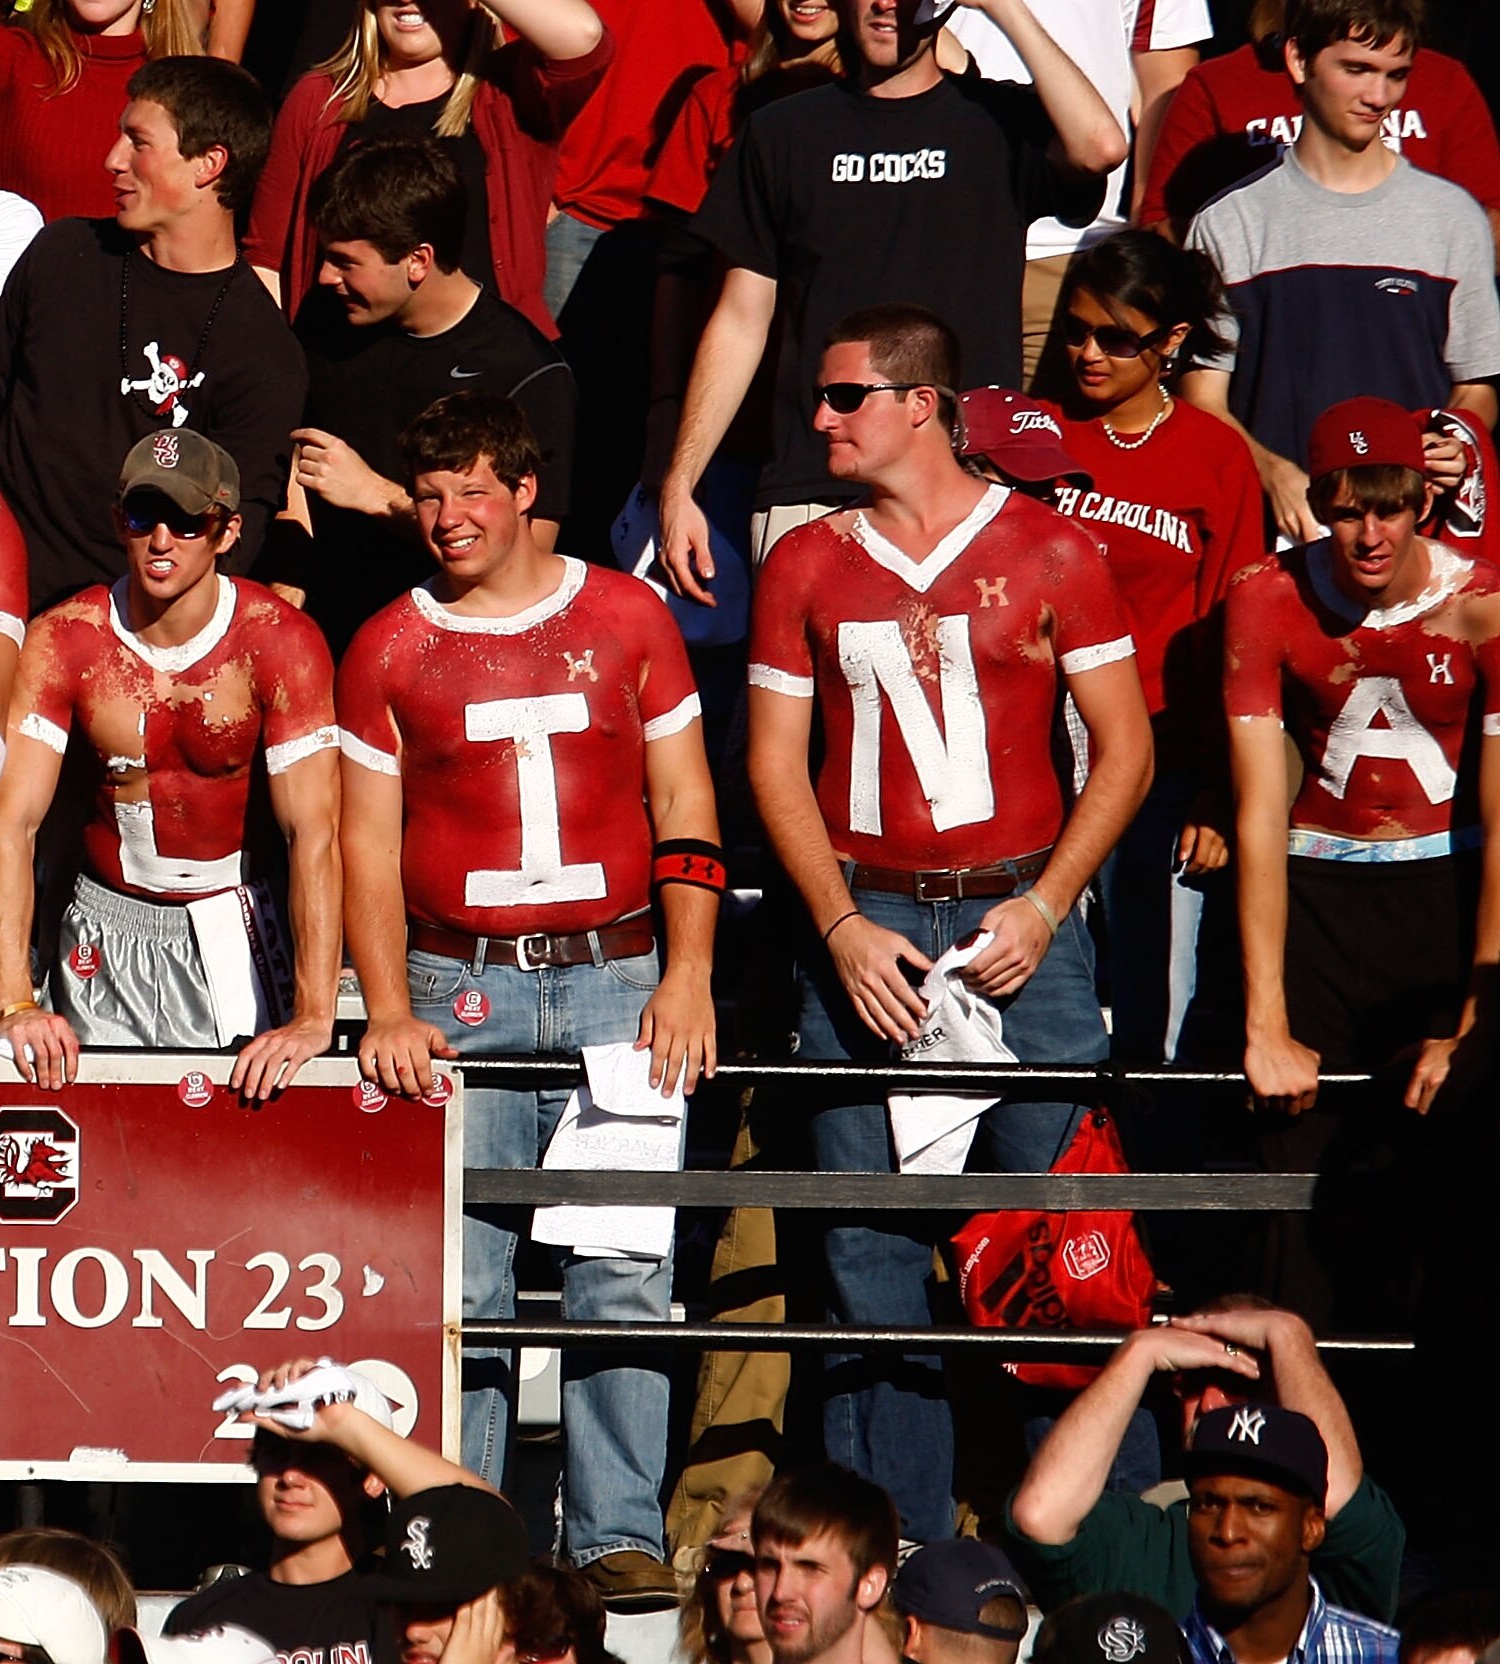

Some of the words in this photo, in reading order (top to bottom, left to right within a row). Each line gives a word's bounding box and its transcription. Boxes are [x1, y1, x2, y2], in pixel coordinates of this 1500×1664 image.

[832, 153, 865, 182] GO
[869, 148, 946, 183] COCKS
[1079, 491, 1194, 554] CAROLINA
[837, 613, 995, 837] N
[1319, 676, 1458, 806] A
[463, 692, 608, 908] I
[243, 1251, 345, 1331] 23
[1226, 1407, 1266, 1446] NY
